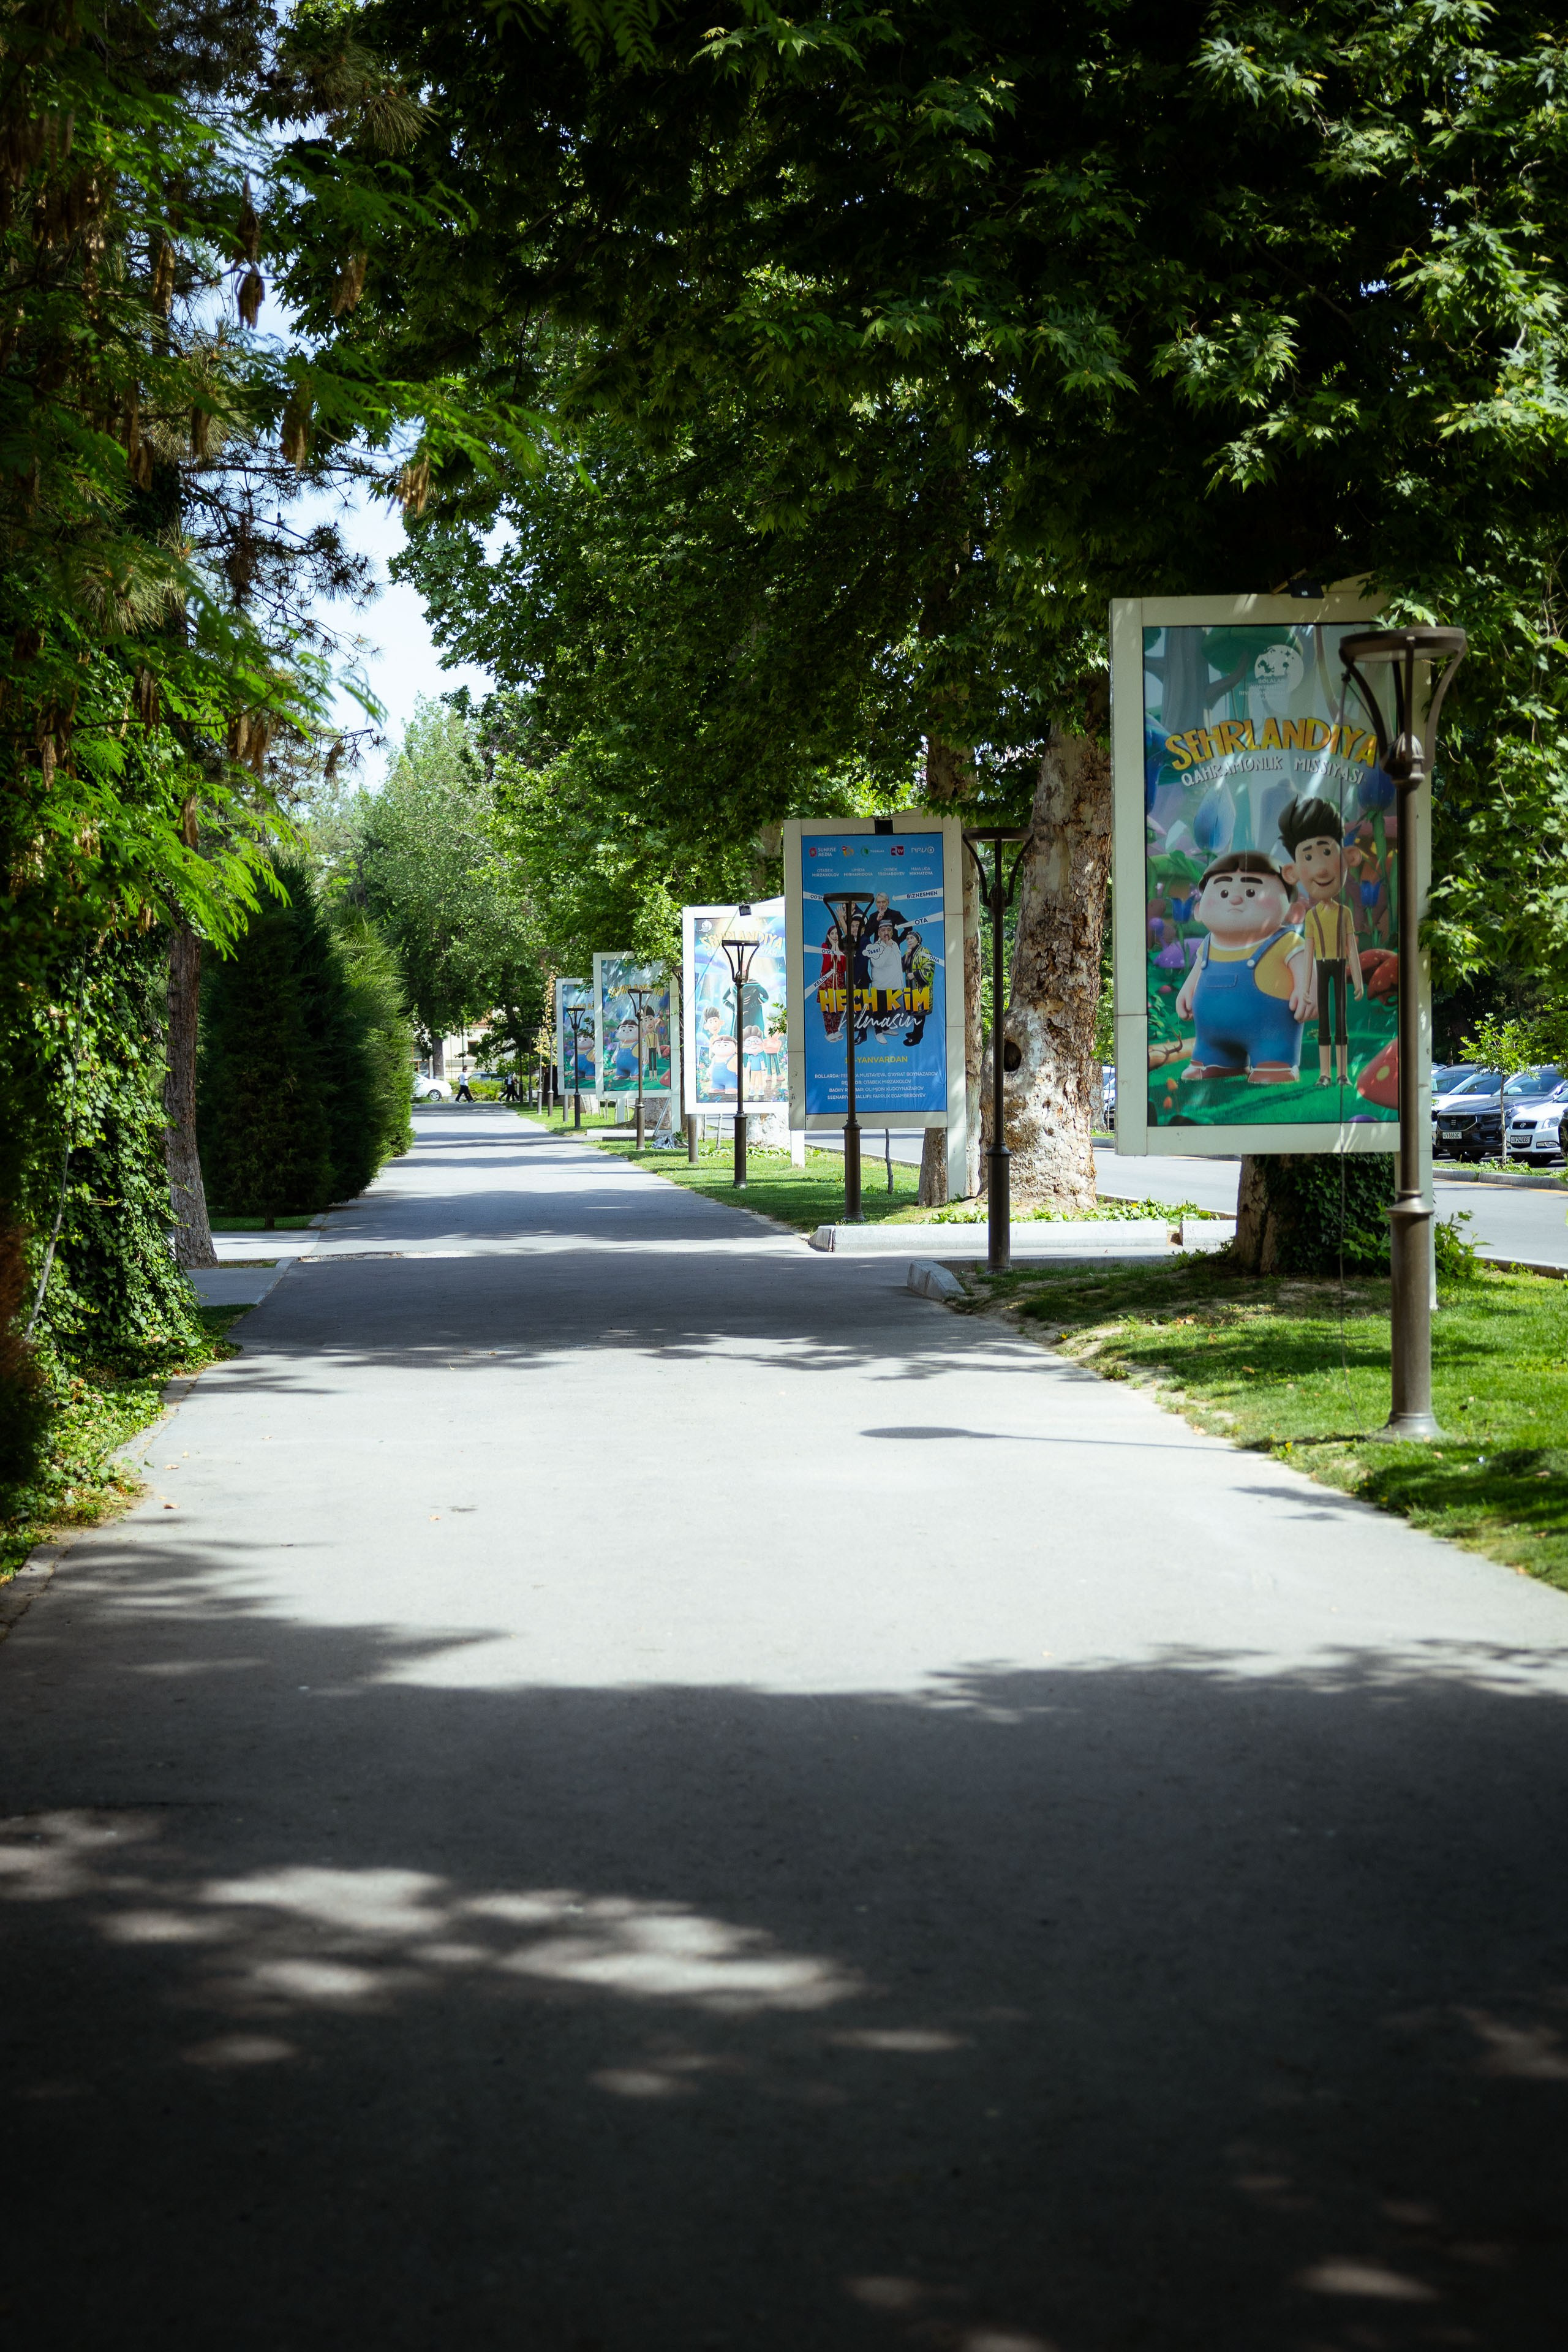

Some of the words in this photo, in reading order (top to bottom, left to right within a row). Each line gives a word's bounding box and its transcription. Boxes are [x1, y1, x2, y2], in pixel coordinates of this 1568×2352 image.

[1165, 717, 1378, 771] SEHRLANDIYA
[1181, 756, 1283, 786] QAHRAMONLIK
[1294, 757, 1365, 785] MISSIYASI
[813, 975, 827, 987] KELIN
